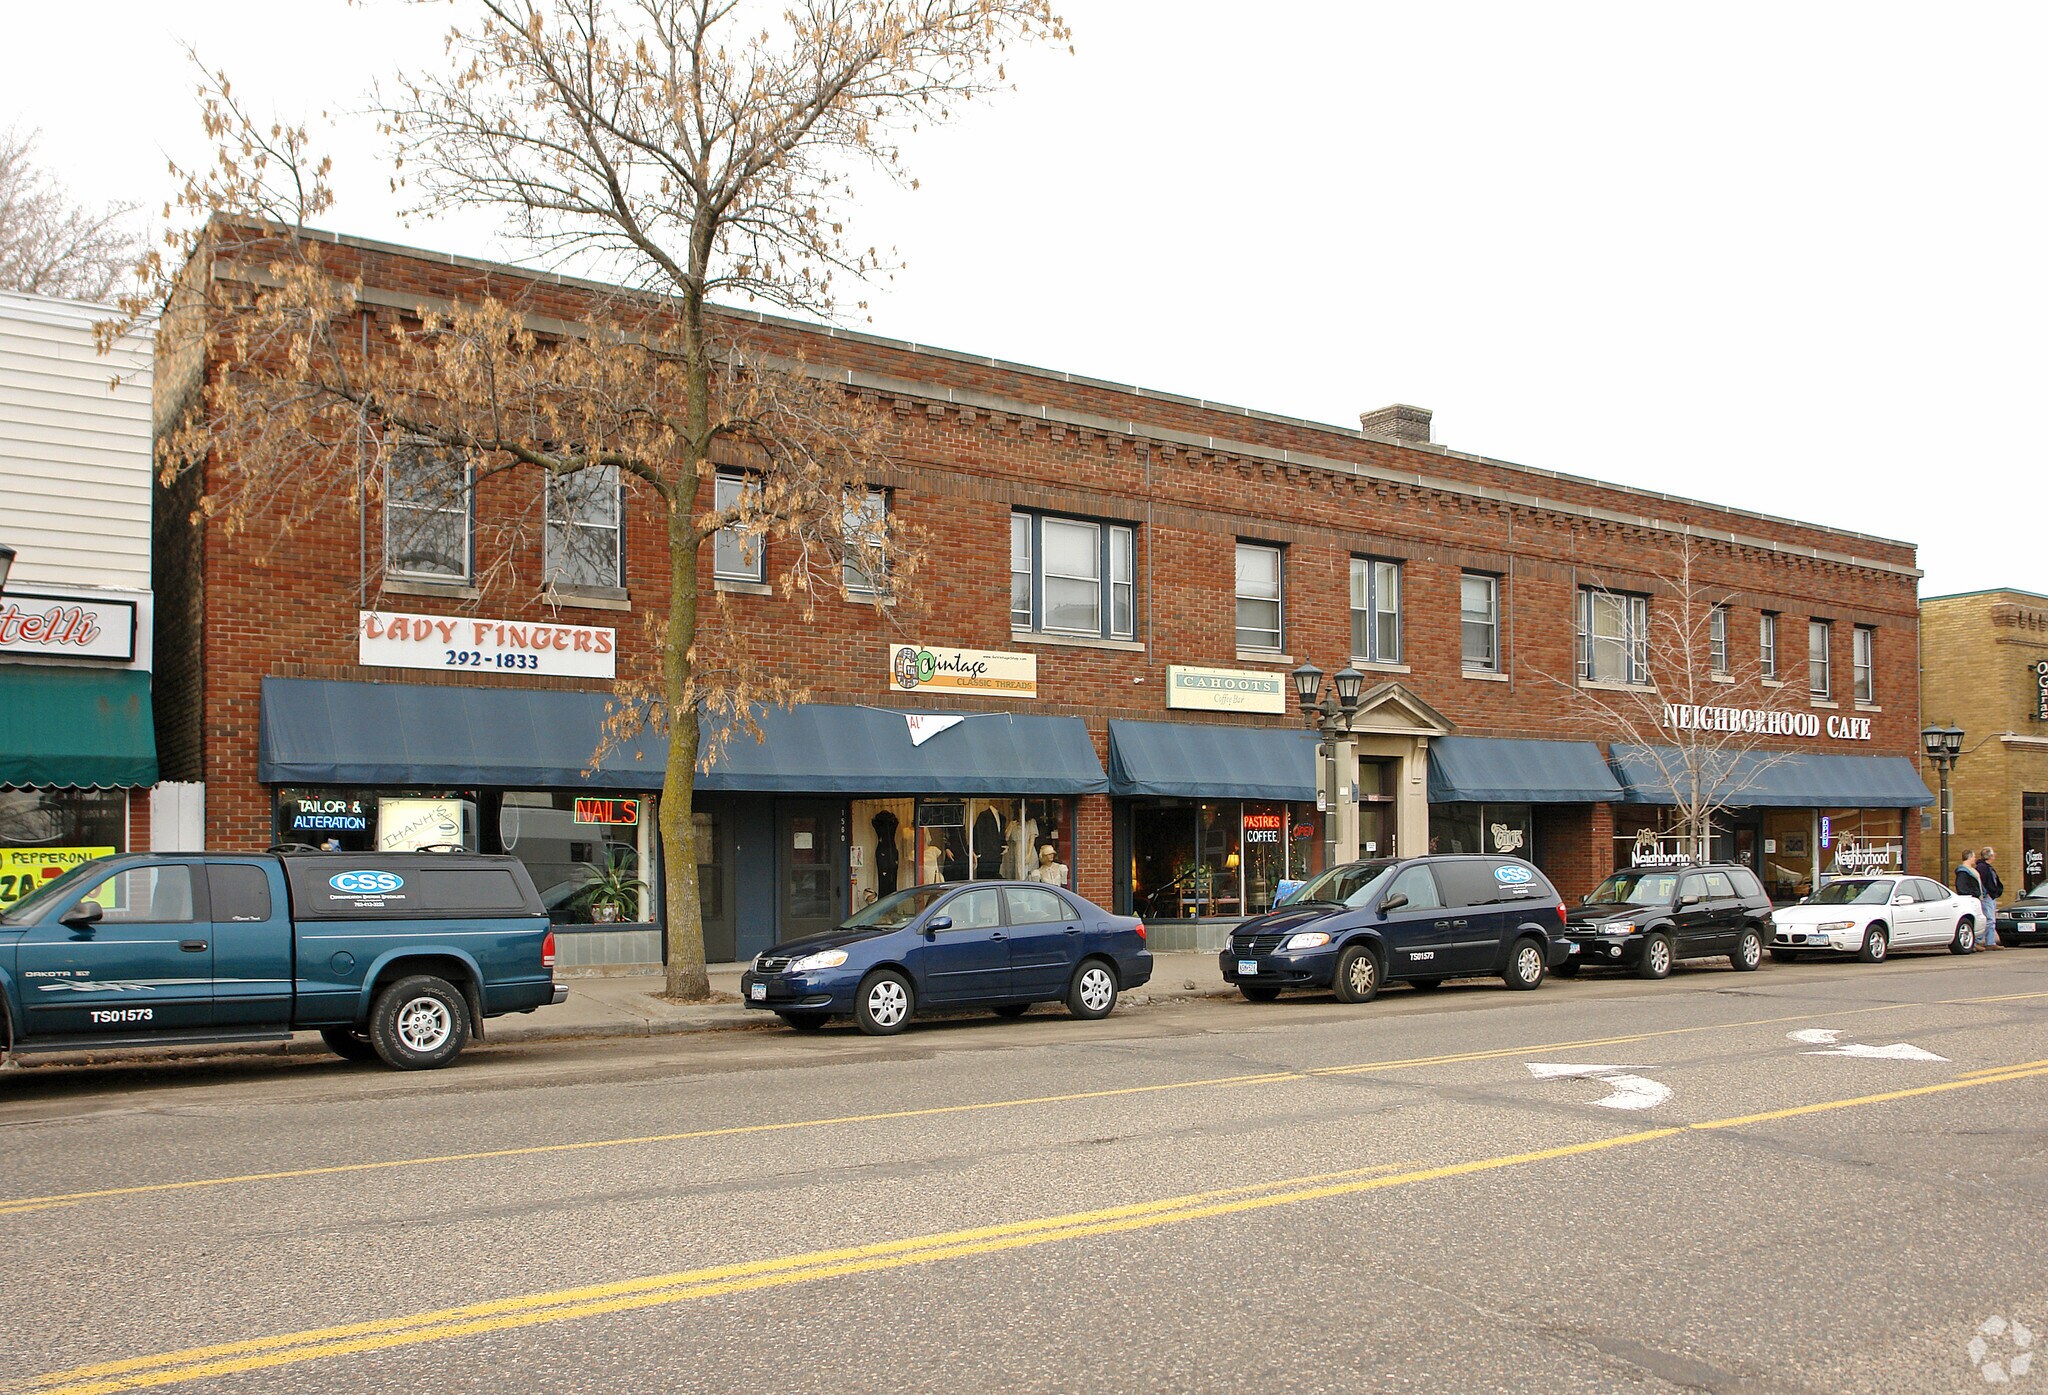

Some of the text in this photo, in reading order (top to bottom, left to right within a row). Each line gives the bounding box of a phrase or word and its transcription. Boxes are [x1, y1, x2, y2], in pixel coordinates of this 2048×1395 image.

[366, 617, 613, 653] LADY FINGERS
[446, 650, 539, 669] 292-1833
[957, 678, 1032, 689] CLASSIC THREADS
[1183, 676, 1271, 692] CAHOOTS
[1214, 693, 1245, 705] Coffee Bar
[1663, 703, 1871, 740] NEIGHBORHOOD CAFE
[298, 800, 363, 813] TAILOR &
[577, 800, 636, 822] NAILS
[294, 815, 366, 829] ALTERATION
[1244, 816, 1280, 828] PASTRIES
[1247, 830, 1278, 842] COFFEE
[1294, 825, 1314, 837] OPEN
[1632, 841, 1703, 867] Neighborhod
[1835, 842, 1889, 868] Neighborhood
[1498, 868, 1529, 881] CSS
[337, 874, 397, 890] CSS
[1409, 951, 1434, 961] TS01573
[90, 1008, 153, 1023] TS01573
